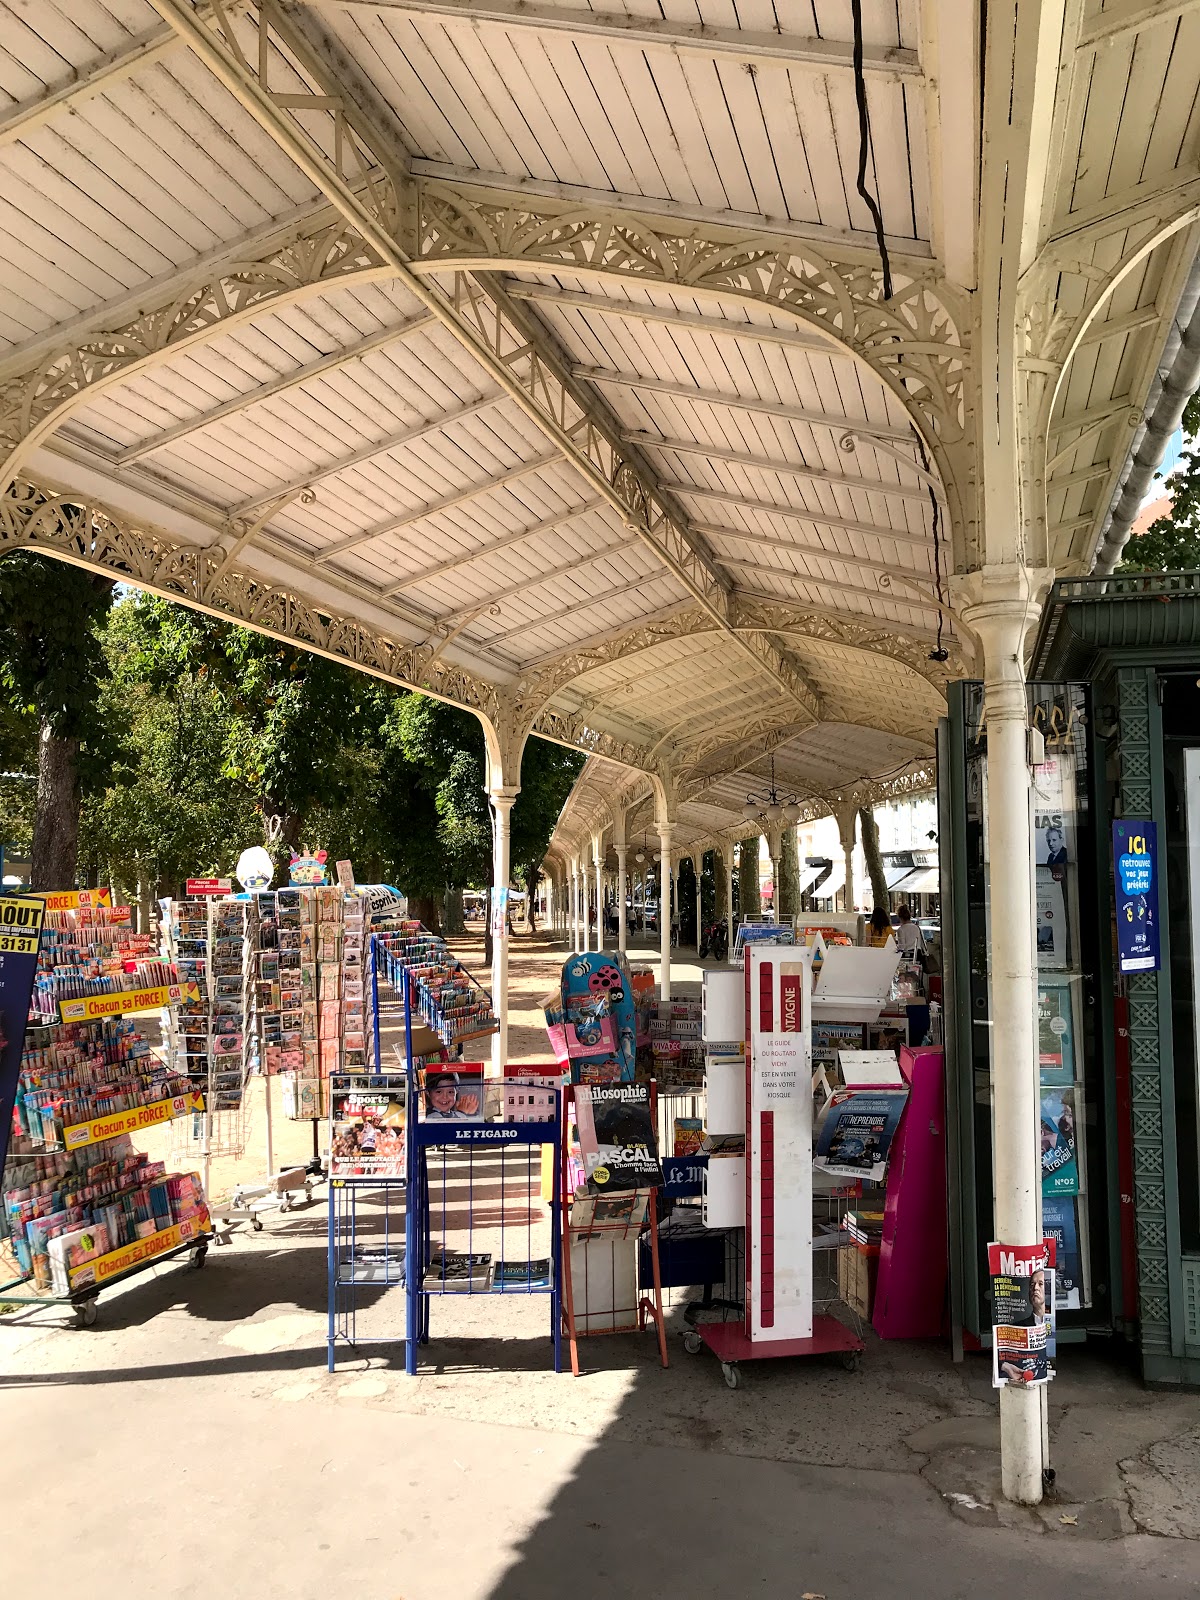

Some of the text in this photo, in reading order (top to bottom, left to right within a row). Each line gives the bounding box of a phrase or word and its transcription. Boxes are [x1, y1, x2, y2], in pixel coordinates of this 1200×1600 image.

[1128, 835, 1147, 854] ICI
[1122, 859, 1151, 868] retrouvez
[1137, 870, 1149, 880] jeux
[1126, 881, 1149, 891] préférés
[45, 895, 69, 910] ORCE
[79, 892, 91, 903] GH
[0, 904, 41, 927] OUT
[2, 938, 32, 952] 31 31
[169, 987, 180, 998] GH
[88, 1000, 120, 1015] Chacun
[122, 1000, 132, 1009] sa
[134, 991, 160, 1007] FORCE
[784, 986, 796, 1033] NTAGNE
[1038, 1008, 1051, 1017] ins
[348, 1093, 389, 1106] Sports
[579, 1084, 647, 1102] philosophie
[173, 1098, 185, 1110] GH
[92, 1120, 125, 1138] Chacun
[127, 1118, 137, 1128] sa
[138, 1106, 165, 1124] FORCE
[839, 1114, 886, 1126] ENTREPRENDRE
[455, 1130, 518, 1139] LE FIGARO
[586, 1147, 656, 1167] PASCAL
[1046, 1147, 1072, 1172] travail
[667, 1165, 703, 1184] Le M
[179, 1222, 192, 1236] GH
[99, 1254, 130, 1277] Chacun
[132, 1248, 143, 1261] sa
[145, 1233, 171, 1257] FORCE
[1000, 1251, 1045, 1276] Maria
